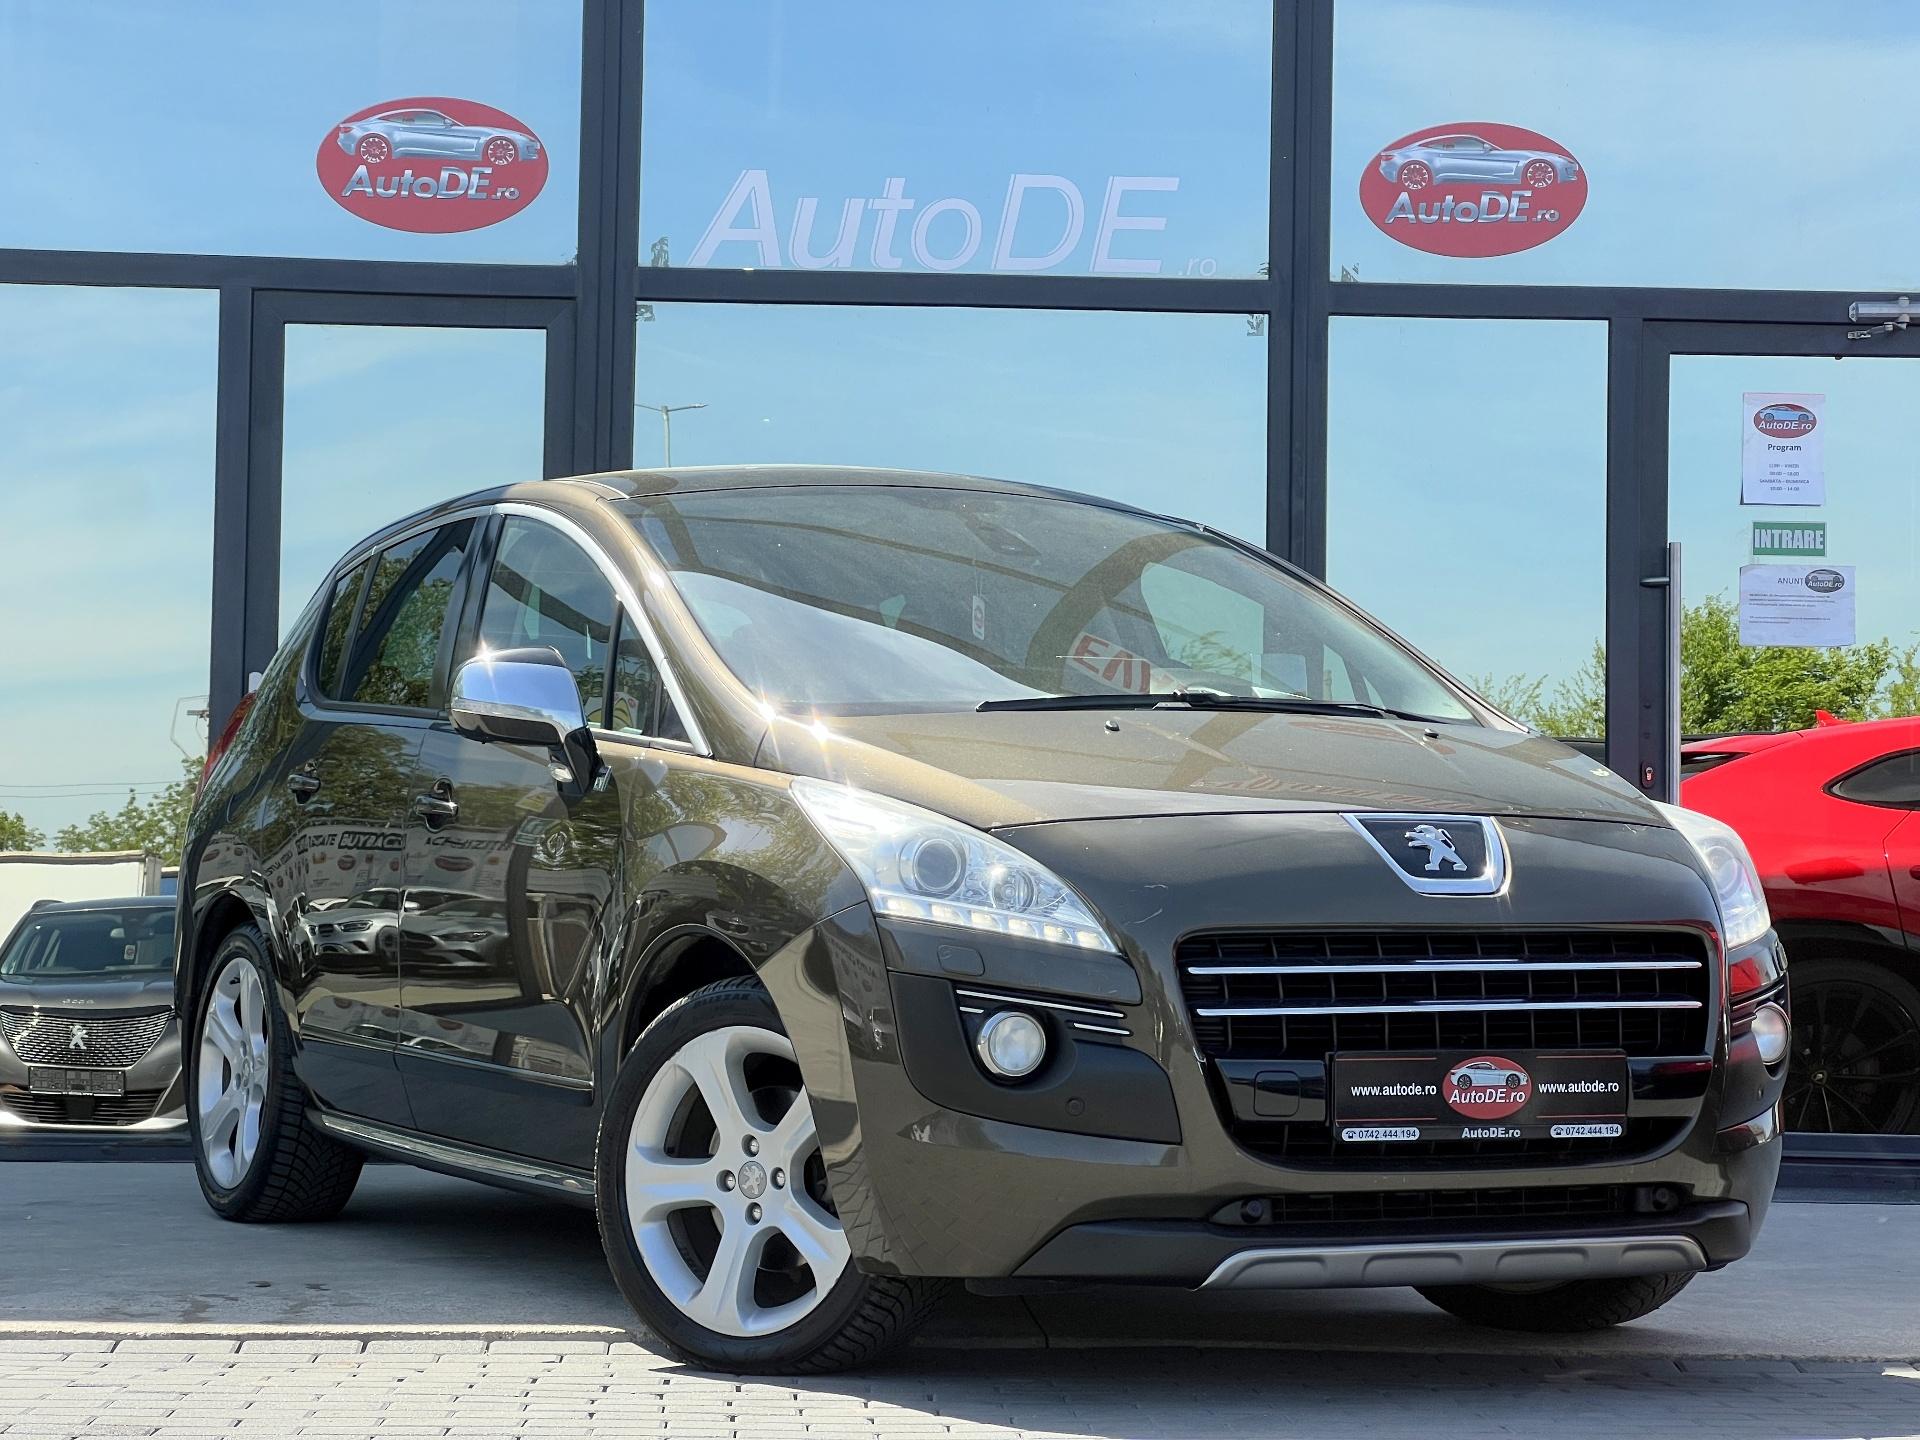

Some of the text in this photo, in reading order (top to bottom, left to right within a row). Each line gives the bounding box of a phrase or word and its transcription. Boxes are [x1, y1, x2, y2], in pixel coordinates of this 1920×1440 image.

[341, 164, 520, 199] AutoDE.ro
[1384, 190, 1560, 224] AutoDE.ro
[1759, 421, 1812, 430] AutoDE.ro
[1767, 443, 1802, 452] Program
[1755, 529, 1824, 549] INTRARE
[1351, 1083, 1437, 1096] www.autode.ro
[1538, 1080, 1619, 1093] www.autode.ro
[1449, 1088, 1526, 1104] AutoDE.ro
[1358, 1129, 1416, 1139] 0742.444.194
[1461, 1127, 1521, 1138] AutoDE.ro
[1565, 1125, 1619, 1136] 0742.444.194
